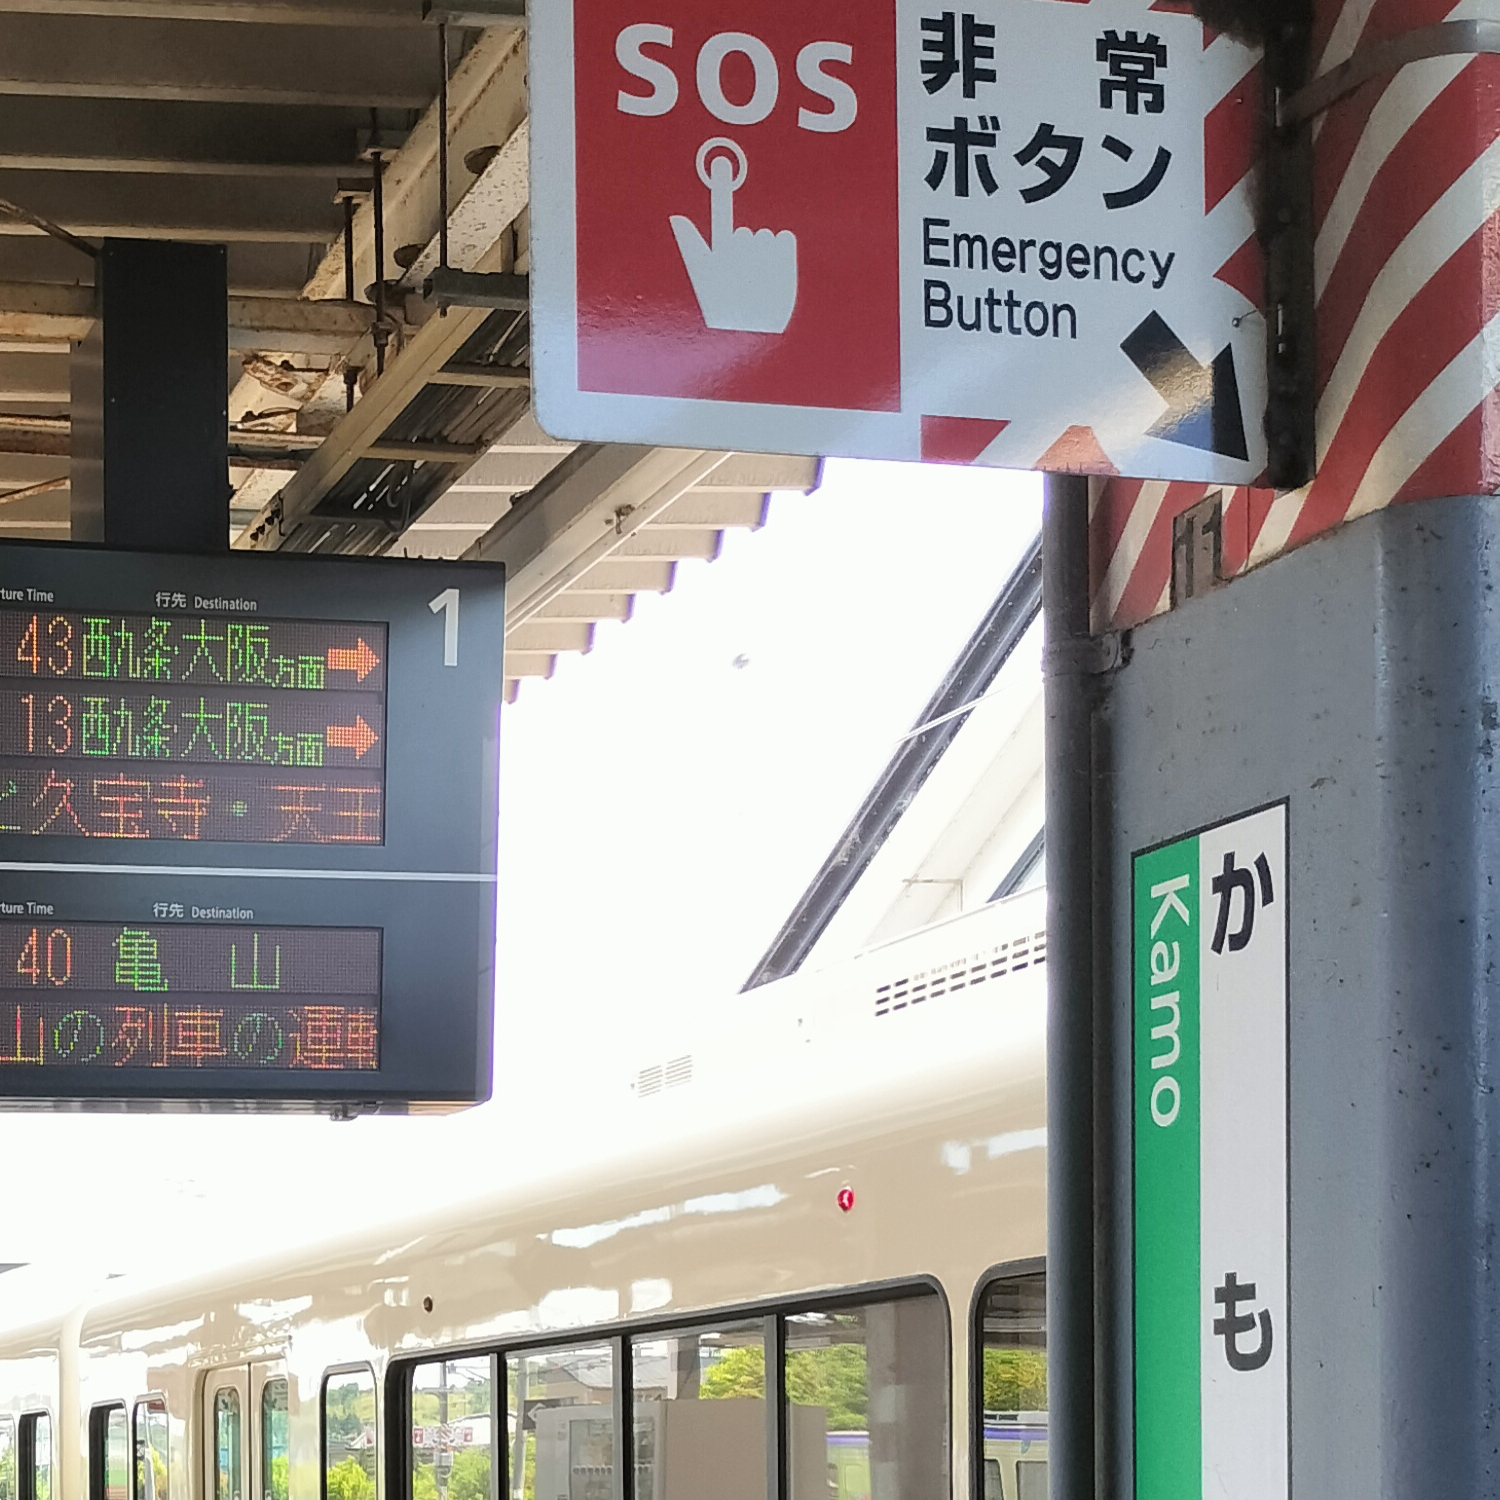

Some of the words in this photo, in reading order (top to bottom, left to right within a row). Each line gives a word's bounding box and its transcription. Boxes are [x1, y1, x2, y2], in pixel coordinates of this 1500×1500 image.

[614, 23, 858, 133] SOS
[920, 11, 1169, 116] 非常
[923, 114, 1174, 211] ボタン
[922, 217, 1175, 290] Emergency
[924, 279, 1077, 340] Button
[27, 588, 55, 603] Time
[156, 592, 187, 608] 行先
[194, 595, 257, 611] Destination
[428, 587, 460, 667] 1
[26, 901, 54, 916] Time
[152, 901, 184, 920] 行先
[190, 904, 255, 921] Destination
[1150, 873, 1191, 1128] Kamo
